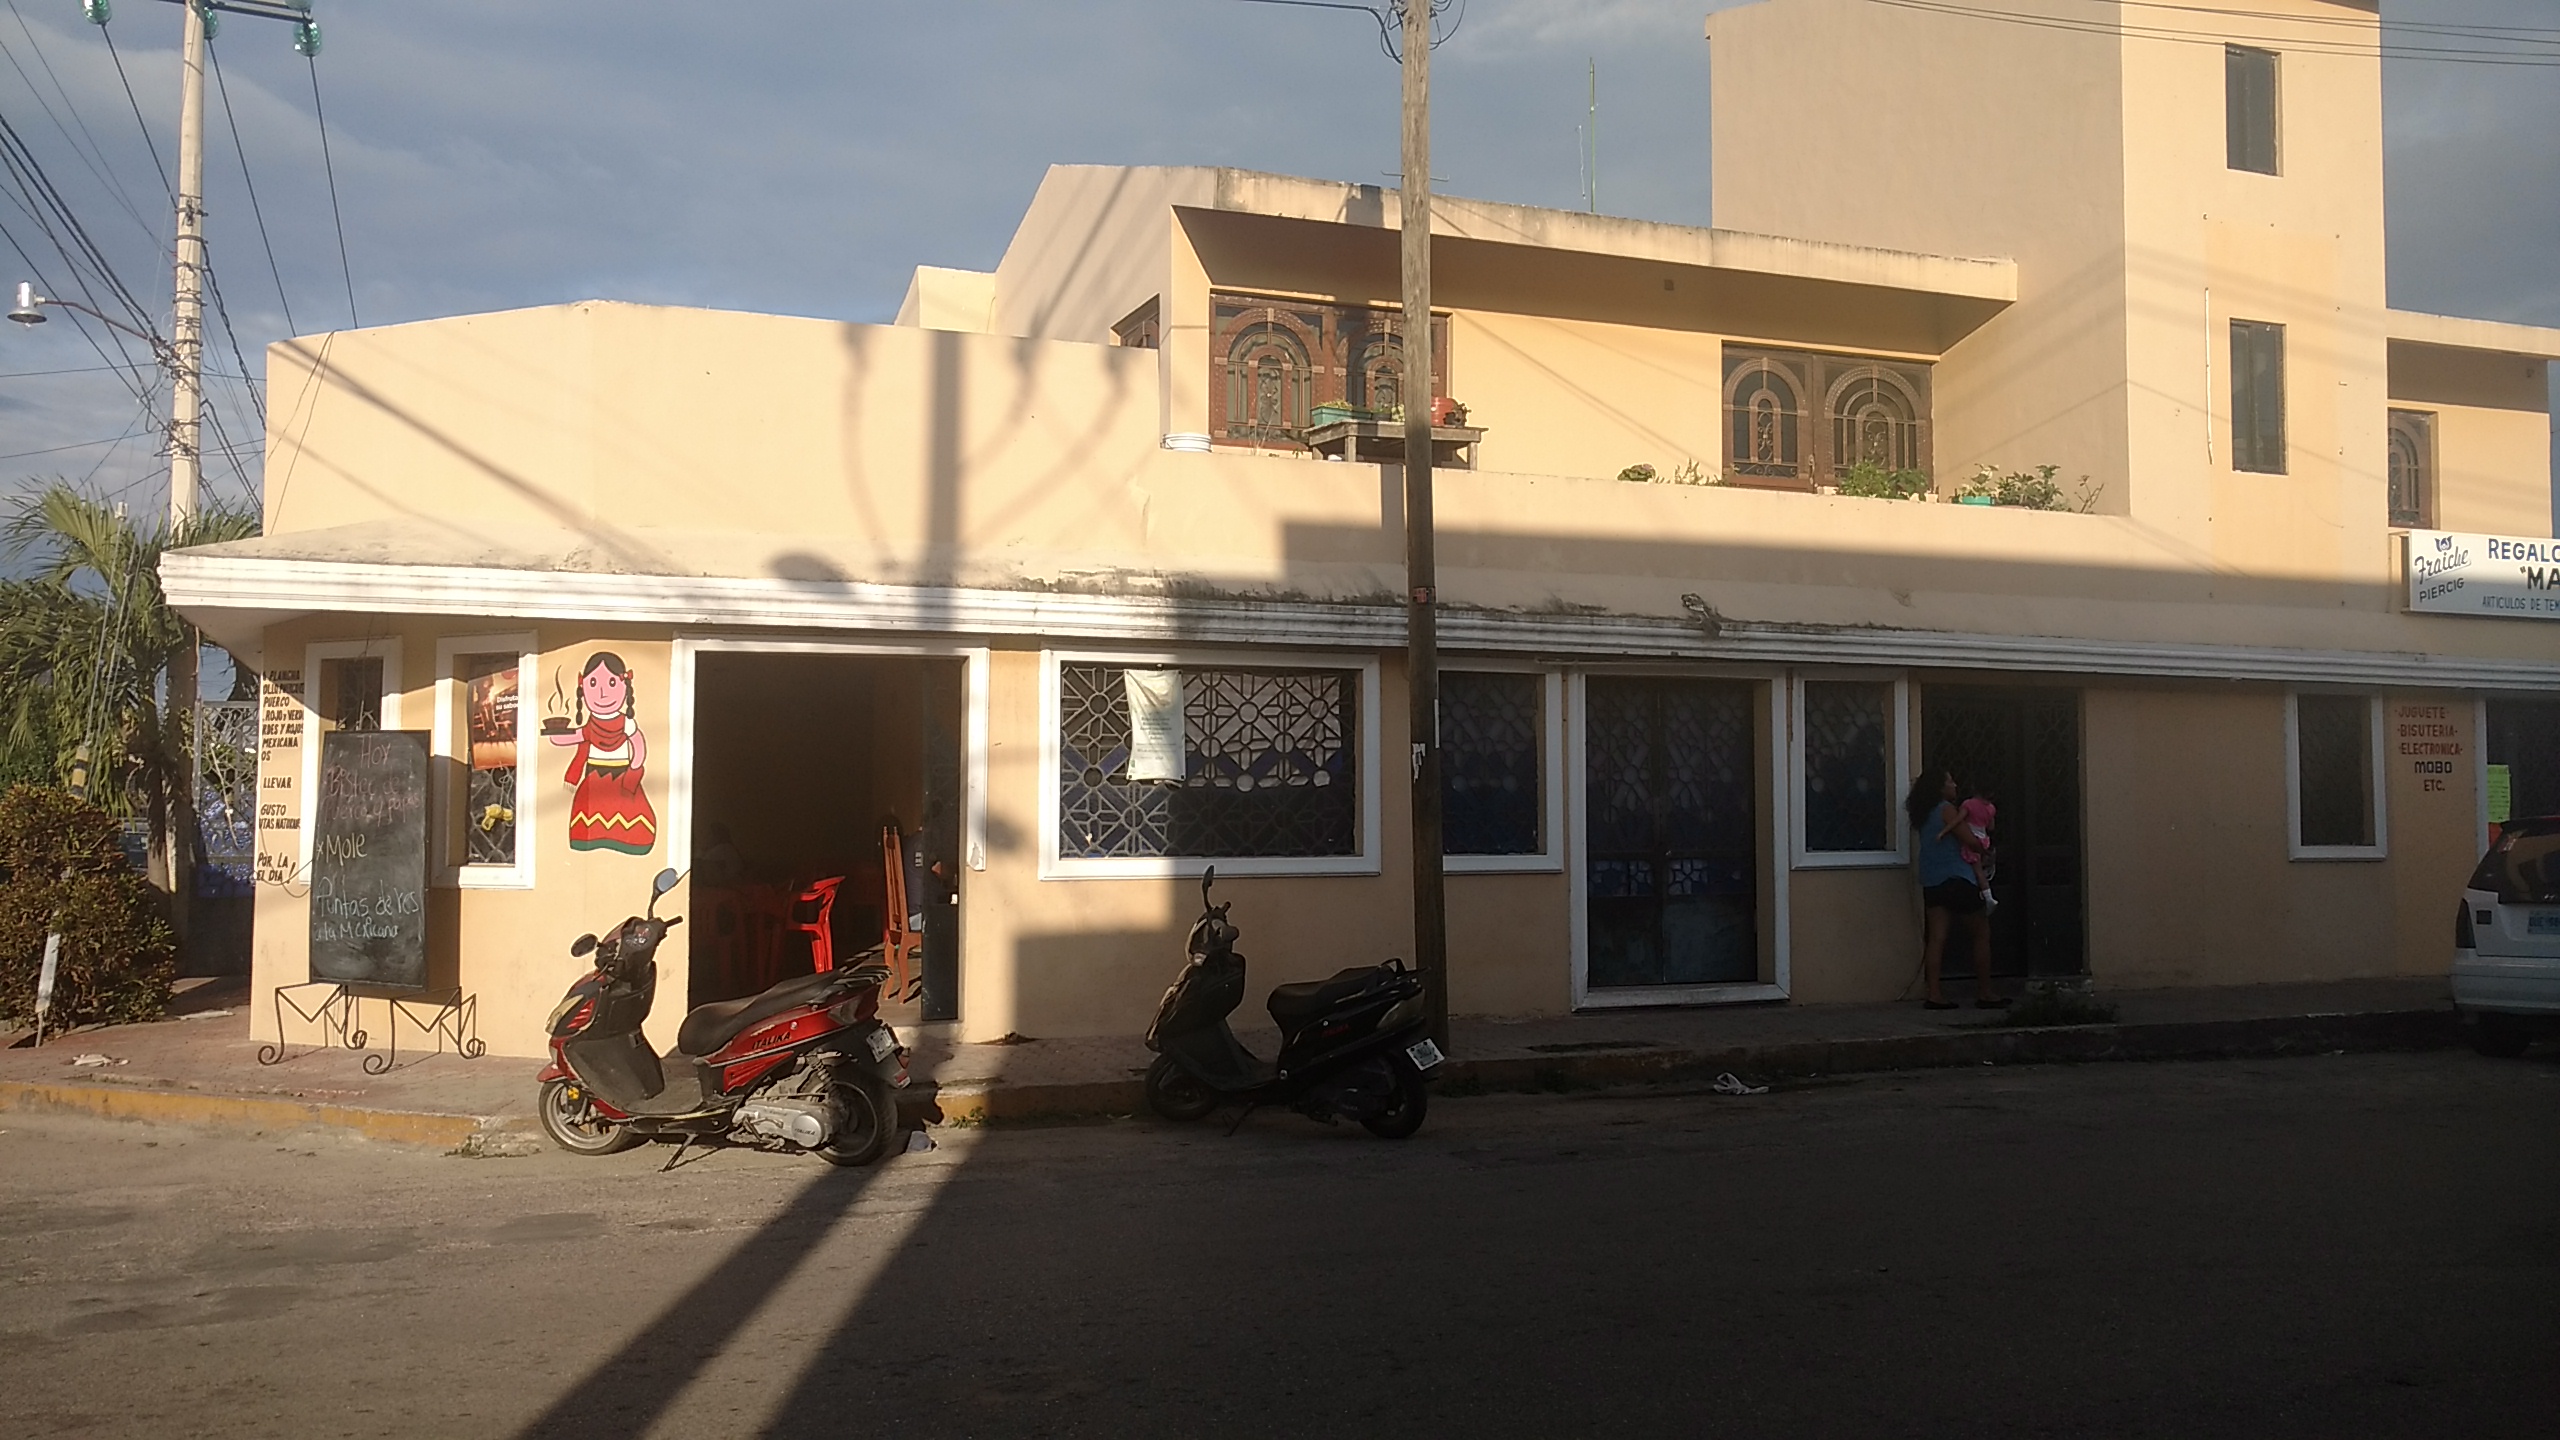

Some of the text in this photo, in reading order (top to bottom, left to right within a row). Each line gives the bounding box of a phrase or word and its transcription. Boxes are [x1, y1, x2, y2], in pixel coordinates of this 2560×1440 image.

[2414, 546, 2471, 585] Fraiche
[2419, 577, 2465, 603] PIERCIG
[2482, 595, 2526, 610] ARTICULOS
[2530, 598, 2541, 611] DE
[263, 696, 290, 708] PUERCO
[266, 709, 283, 721] ROJO
[287, 709, 304, 721] VERD
[280, 724, 286, 735] Y
[262, 737, 298, 749] MEXICANA
[2414, 760, 2453, 774] MOBO
[263, 776, 292, 789] LLEVAR
[260, 804, 287, 816] GUSTO
[277, 852, 289, 868] LA
[375, 879, 393, 916] de
[752, 1031, 791, 1050] ITALIKA
